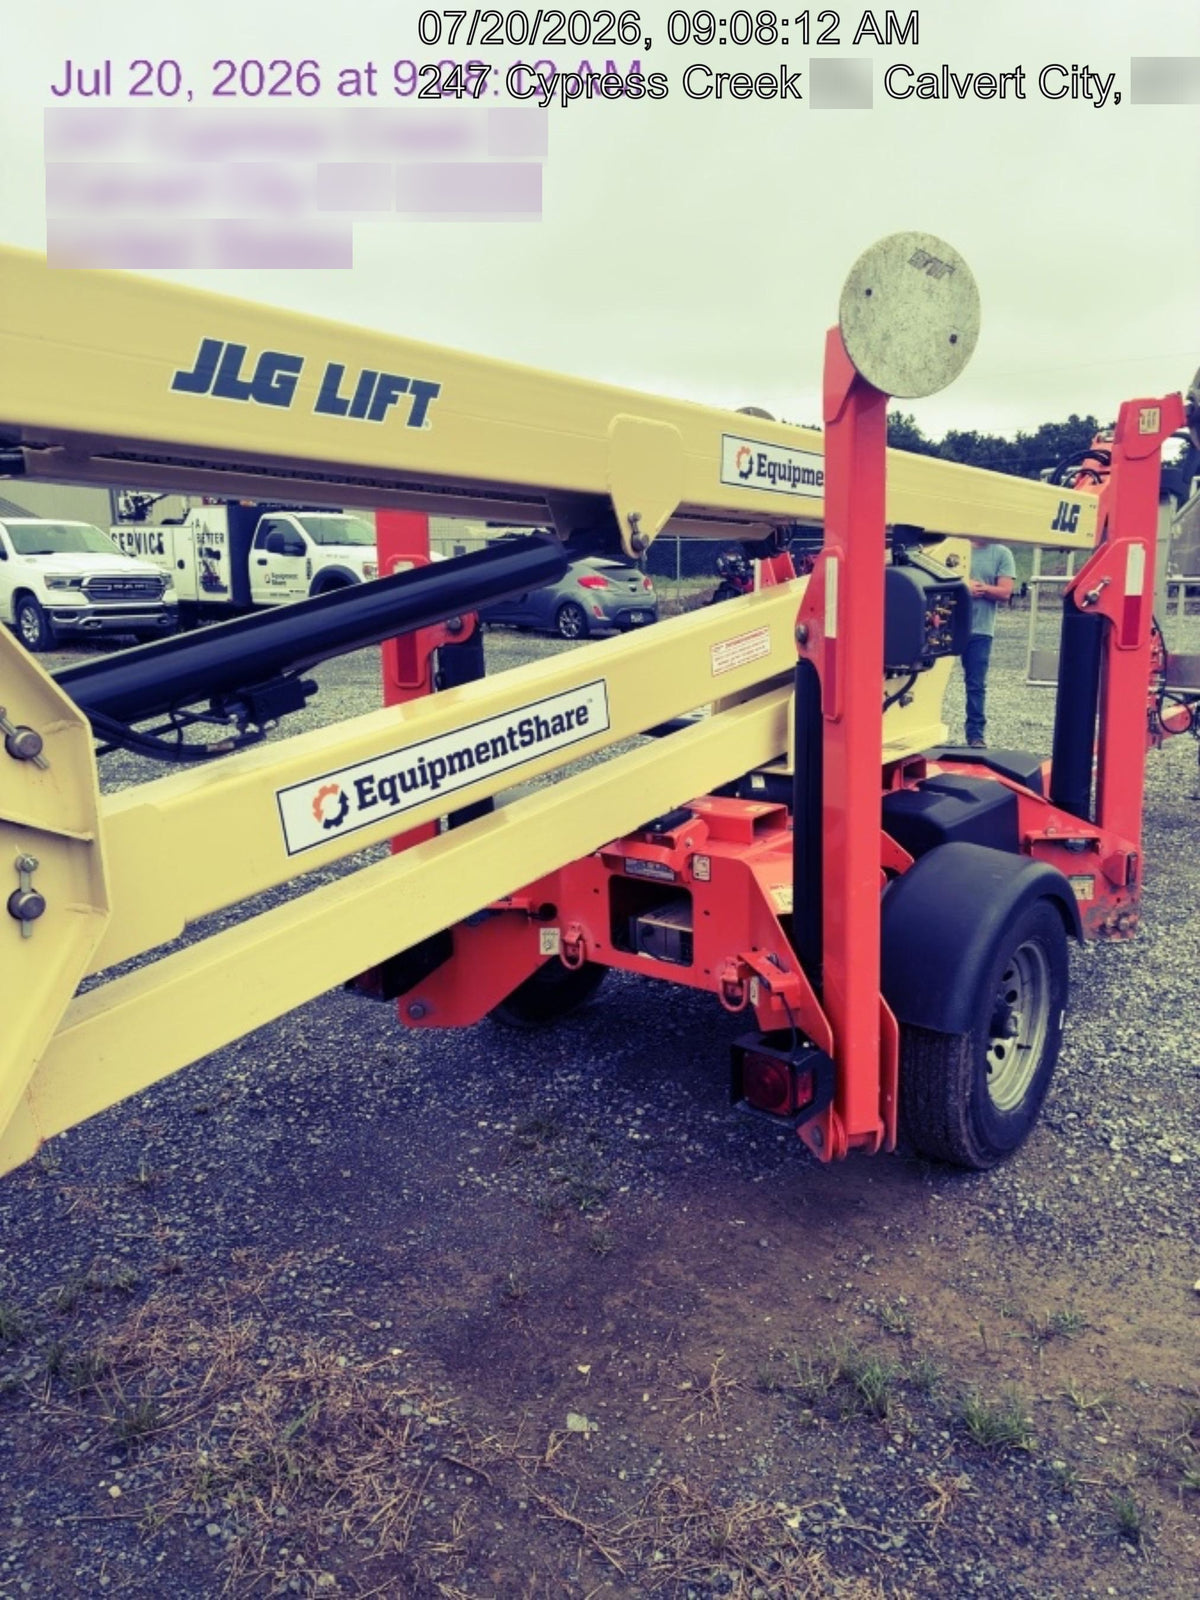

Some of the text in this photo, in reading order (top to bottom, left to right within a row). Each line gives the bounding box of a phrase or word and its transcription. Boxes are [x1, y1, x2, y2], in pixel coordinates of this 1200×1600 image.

[170, 336, 442, 429] JLG LIFT
[1050, 500, 1081, 534] JLG
[352, 703, 591, 812] EquipmentShare
